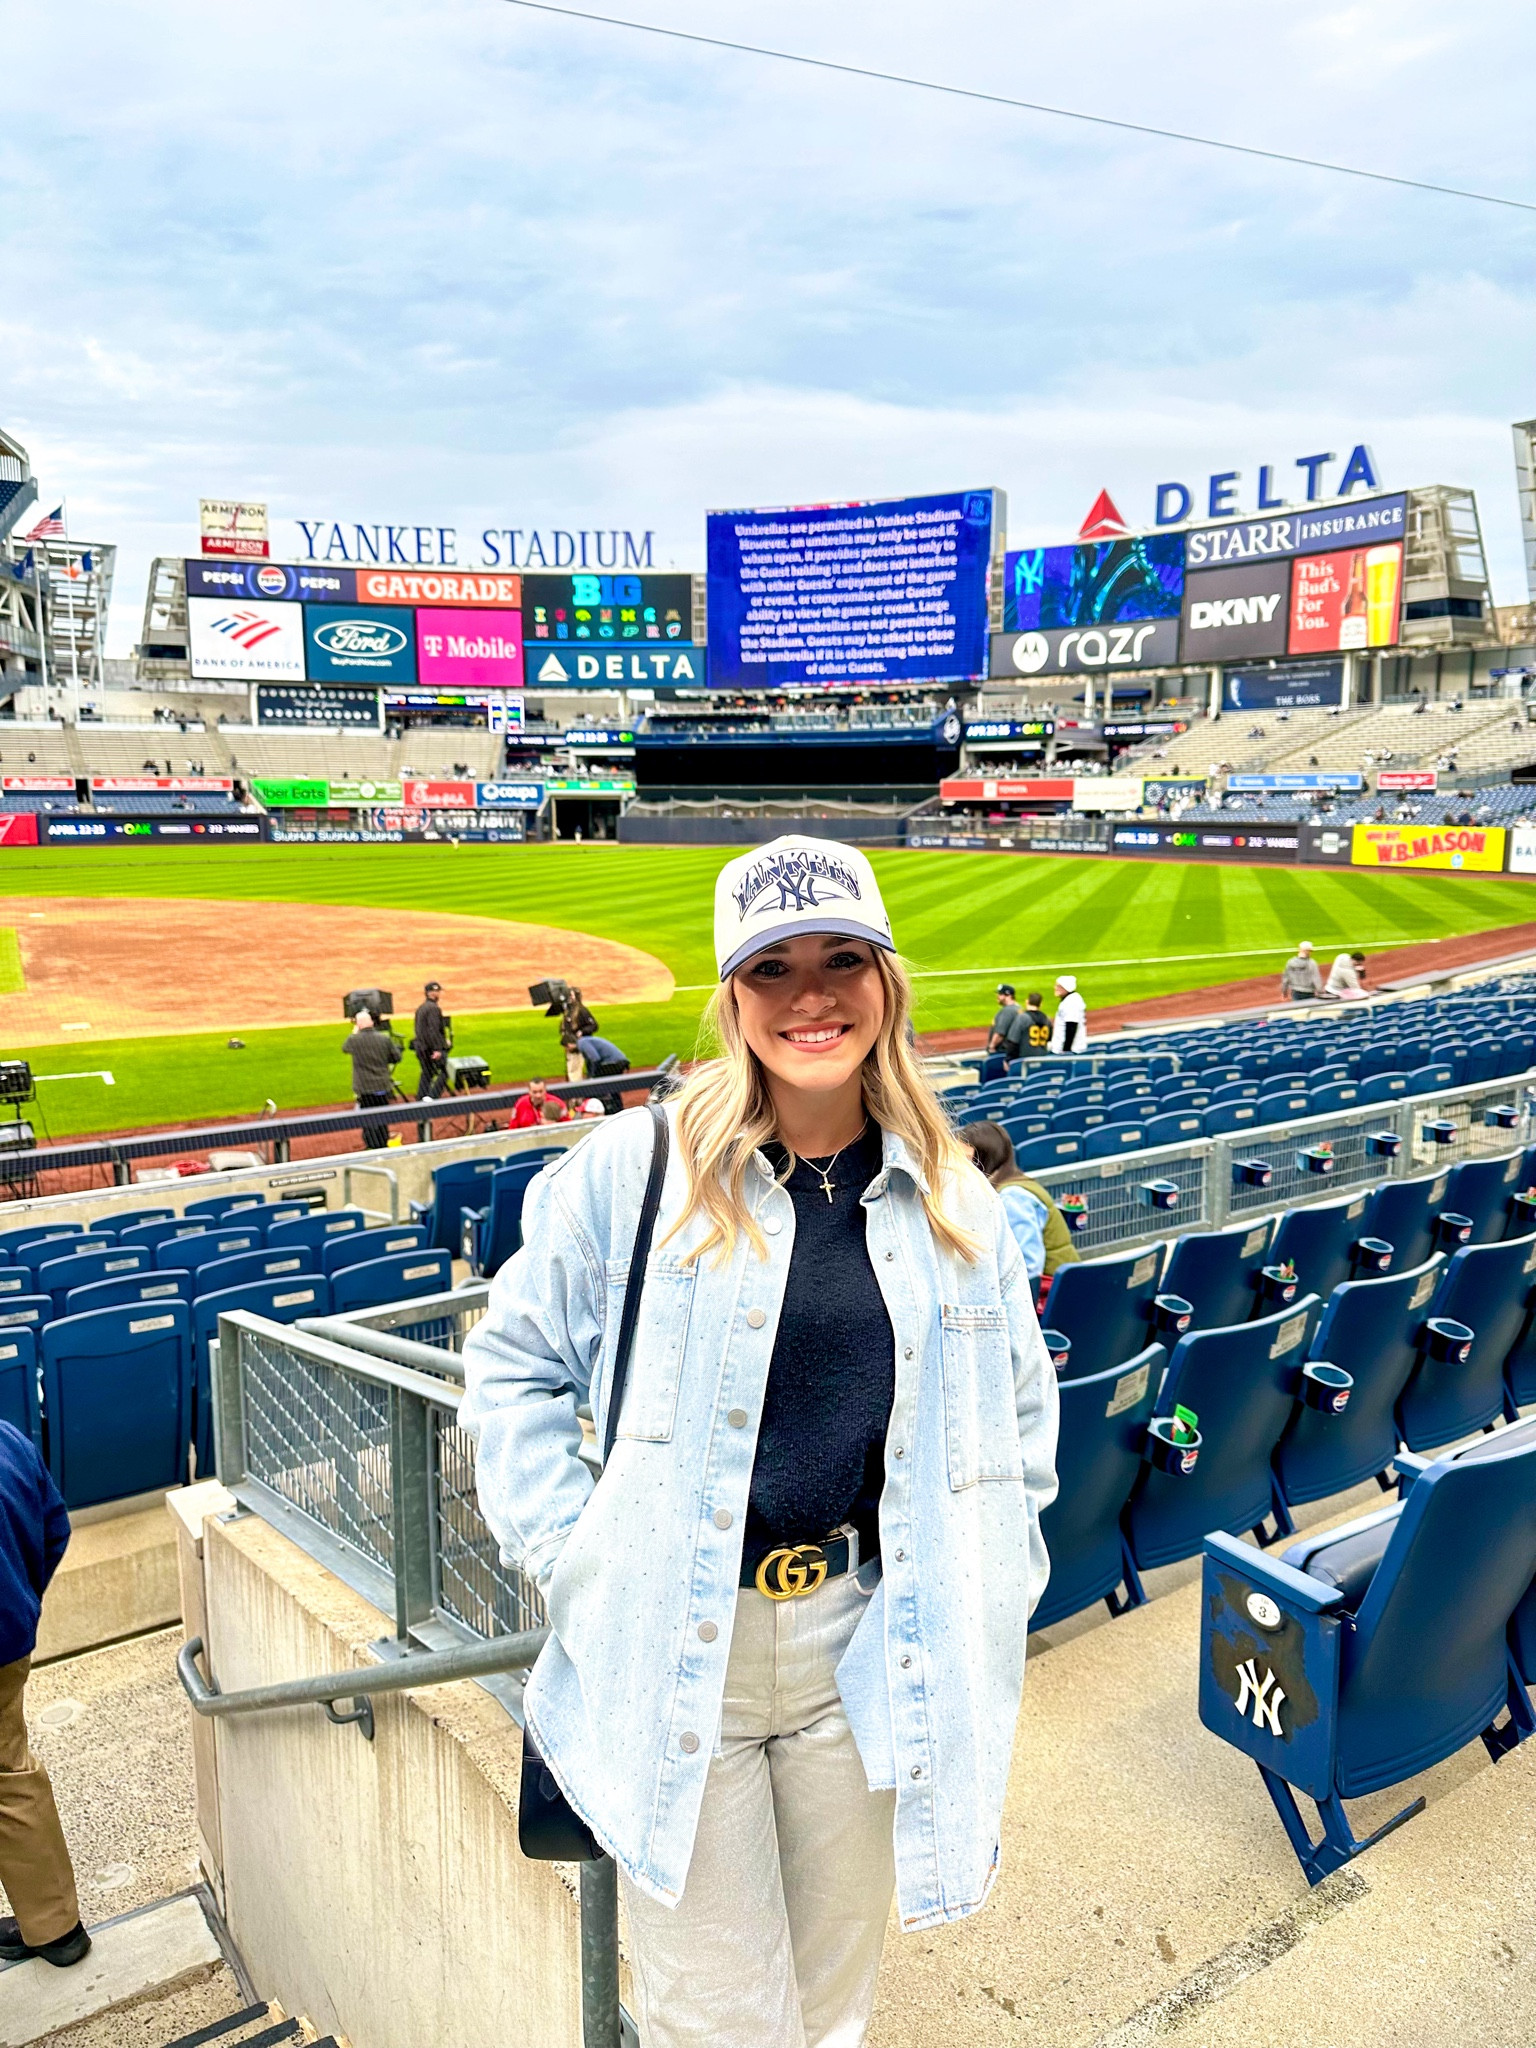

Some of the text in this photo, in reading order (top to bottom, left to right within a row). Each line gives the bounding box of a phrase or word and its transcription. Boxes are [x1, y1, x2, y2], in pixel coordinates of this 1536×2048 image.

[1155, 444, 1379, 526] DELTA
[203, 504, 265, 517] ARMITRON
[735, 509, 964, 536] Umbrellas are permitted in Yankee Stadium.
[207, 538, 264, 551] ARMITRON
[296, 520, 656, 570] YANKEE STADIUM
[790, 537, 805, 548] an
[806, 532, 853, 547] umbrella
[854, 532, 877, 545] may
[878, 528, 903, 543] only
[903, 527, 918, 540] be
[919, 523, 945, 538] used
[1189, 506, 1402, 564] STARR INSURANCE
[742, 552, 773, 564] when
[805, 549, 813, 562] it
[814, 546, 860, 564] provides
[861, 543, 917, 560] protection
[918, 539, 943, 555] only
[943, 538, 956, 551] to
[202, 571, 244, 585] PEPSI
[740, 554, 958, 579] the Guest holding it and does not interfere
[1013, 547, 1045, 596] NY
[1298, 560, 1334, 580] This
[300, 576, 341, 590] PEPSI
[367, 576, 514, 602] GATORADE
[572, 574, 643, 606] BIG
[741, 580, 767, 593] with
[767, 579, 796, 592] other
[836, 573, 893, 590] enjoyment
[894, 571, 906, 585] of
[907, 570, 926, 584] the
[926, 569, 957, 585] game
[1298, 577, 1340, 596] Bud's
[751, 596, 763, 607] or
[798, 595, 811, 605] or
[811, 590, 875, 606] compromise
[875, 587, 905, 600] other
[1298, 597, 1324, 613] For
[746, 608, 781, 622] ability
[782, 608, 795, 620] to
[795, 606, 821, 619] view
[822, 605, 841, 618] the
[841, 605, 871, 619] game
[871, 604, 883, 616] or
[918, 600, 950, 614] Large
[1190, 594, 1281, 630] DKNY
[1296, 614, 1329, 631] You.
[776, 620, 798, 636] golf
[798, 619, 851, 633] umbrellas
[852, 619, 869, 631] are
[870, 617, 888, 631] not
[889, 613, 943, 631] permitted
[943, 612, 956, 625] in
[331, 625, 391, 654] Ford
[447, 635, 517, 660] Mobile
[740, 628, 956, 649] the Stadium. Guests may be asked to close
[1059, 625, 1156, 667] razr
[195, 659, 301, 669] BANK OF AMERICA
[740, 642, 955, 663] their umbrella if it is obstructing the view
[578, 655, 695, 680] DELTA
[805, 660, 887, 675] of other Guests.
[1275, 695, 1320, 706] THE BOSS
[292, 787, 326, 800] Eats
[123, 823, 152, 836] OAK
[1172, 832, 1197, 846] OAK
[776, 868, 820, 912] NY
[1029, 1025, 1049, 1047] 99
[1234, 1658, 1286, 1737] NY
